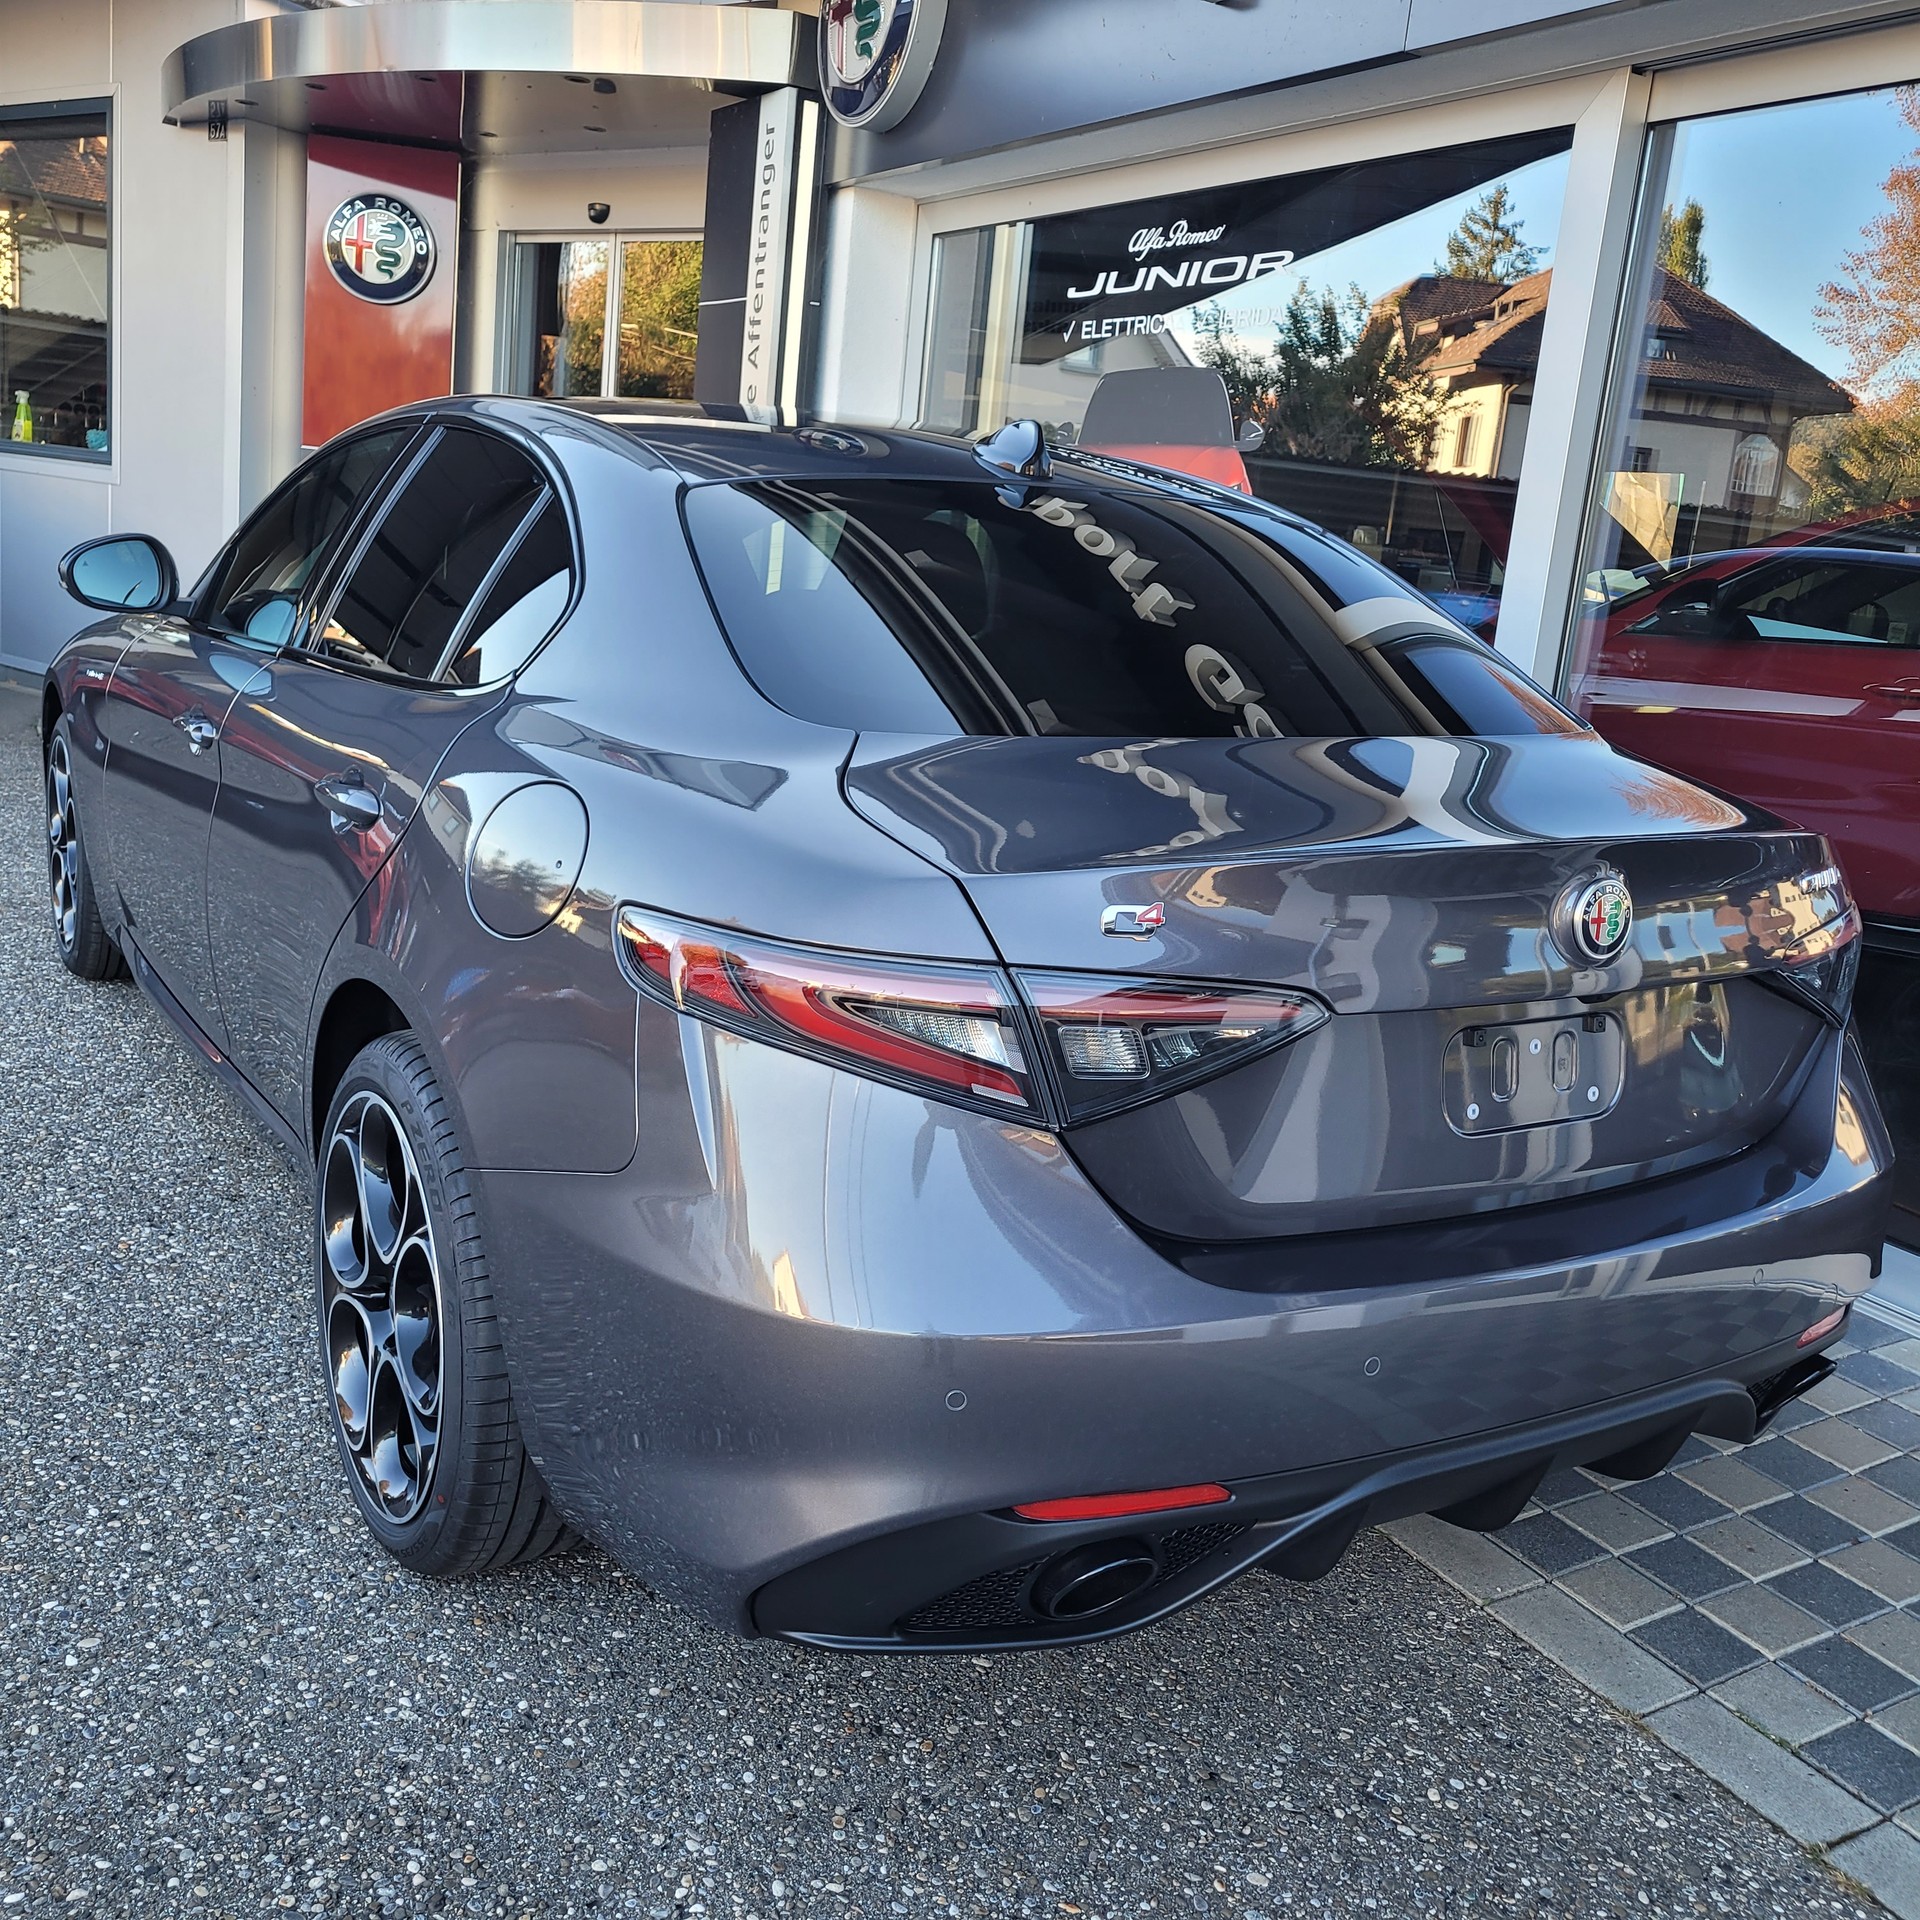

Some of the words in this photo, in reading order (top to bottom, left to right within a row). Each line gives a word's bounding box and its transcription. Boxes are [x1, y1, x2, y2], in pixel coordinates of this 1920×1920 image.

[330, 199, 367, 242] ALFA
[373, 197, 428, 255] ROMEO
[747, 122, 777, 370] Affentranger
[1127, 226, 1167, 262] Alfa
[1164, 218, 1227, 249] Romeo
[1066, 250, 1296, 299] JUNIOR
[1100, 901, 1166, 942] Q4
[1583, 890, 1603, 922] ALFA
[409, 1121, 443, 1213] ZERO
